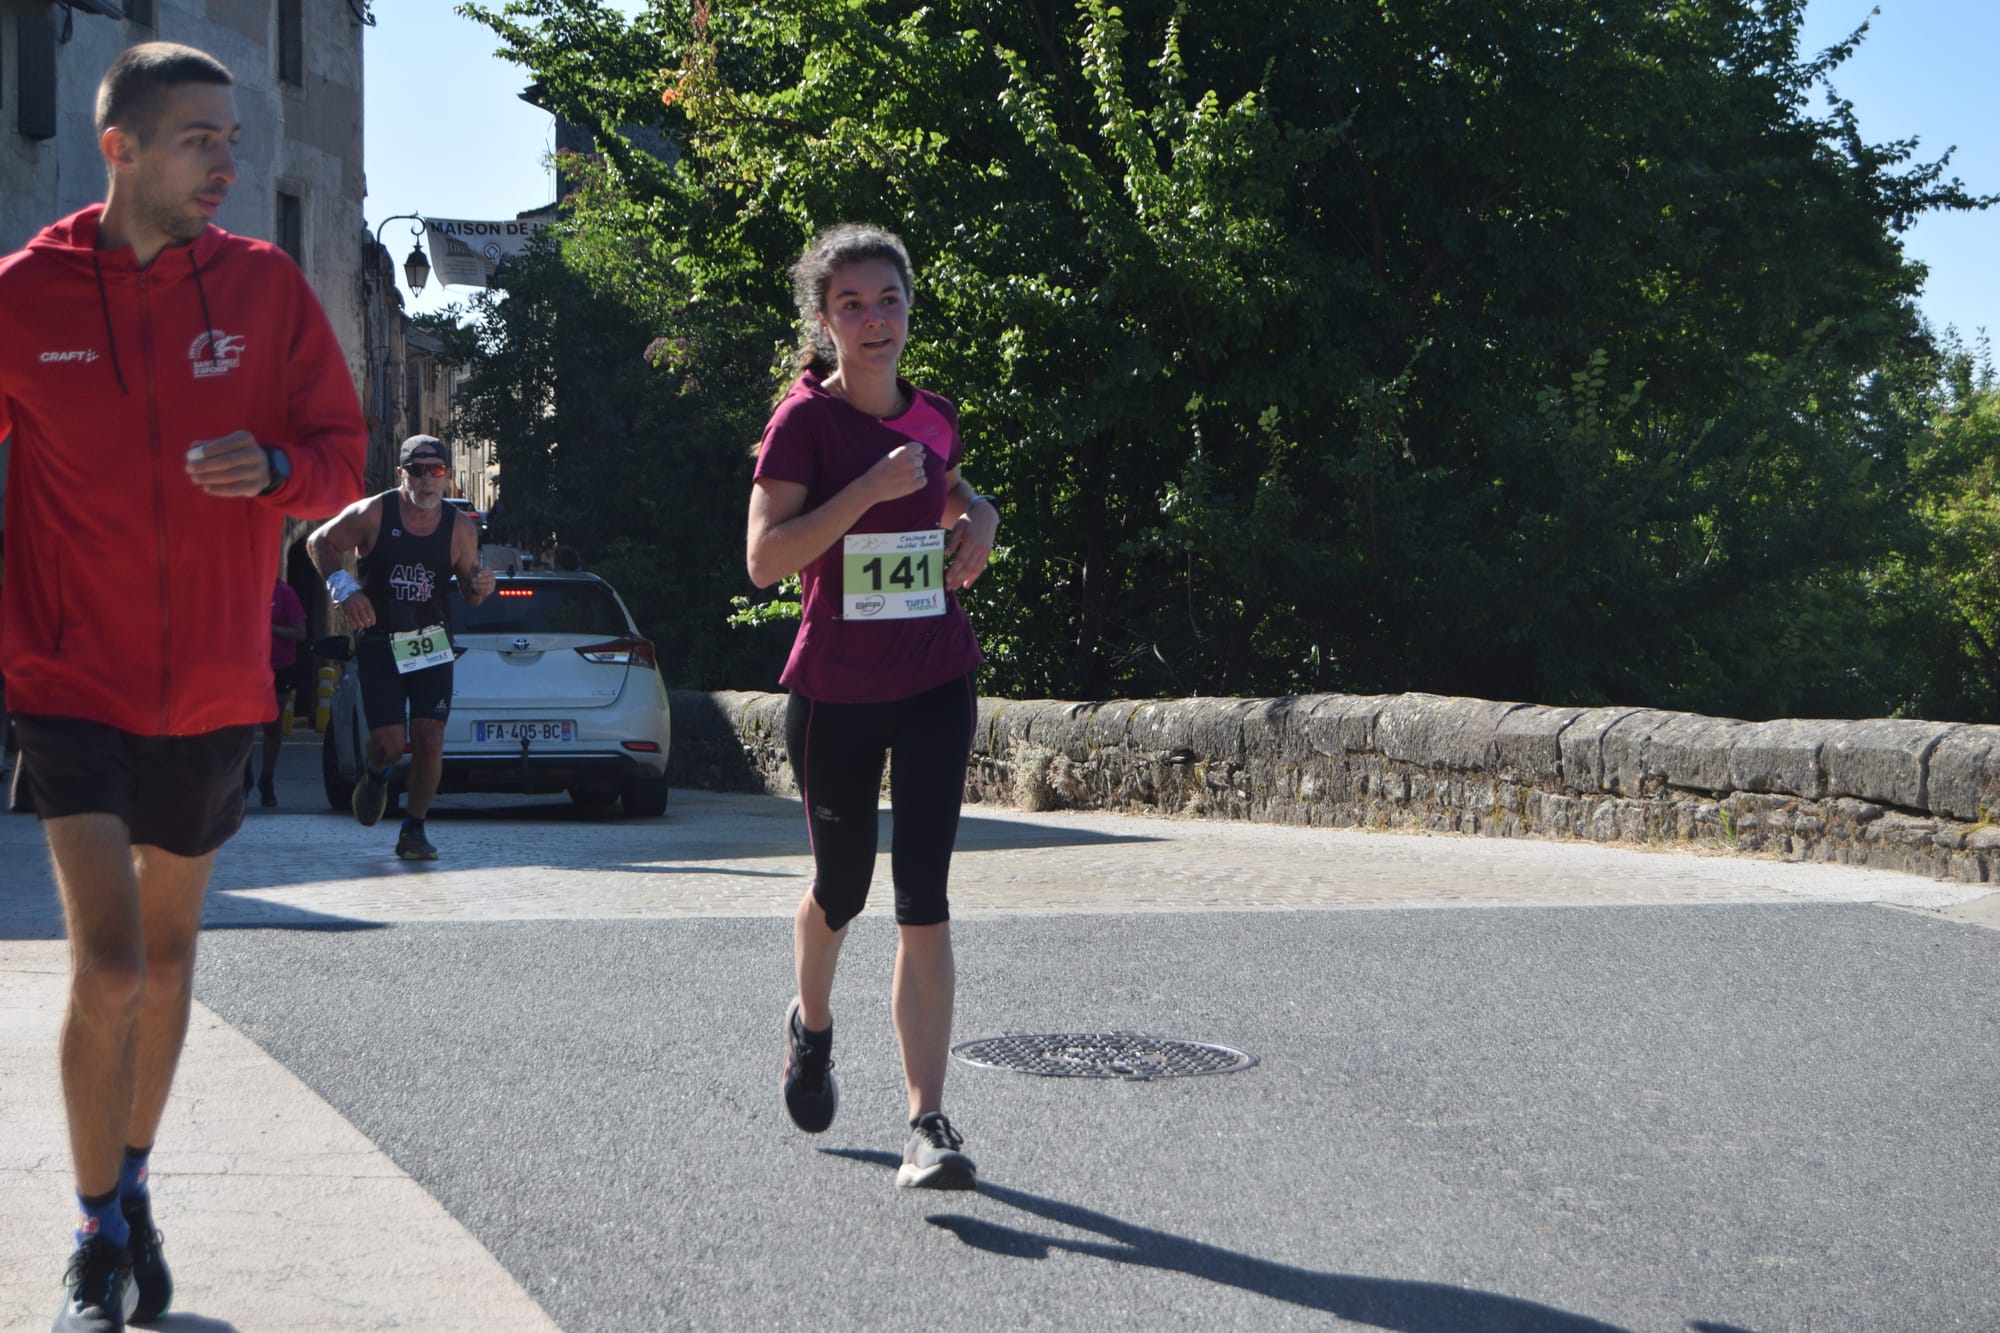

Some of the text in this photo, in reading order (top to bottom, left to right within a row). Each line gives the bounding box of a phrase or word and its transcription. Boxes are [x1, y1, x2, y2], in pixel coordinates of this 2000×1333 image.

[431, 222, 500, 235] MAISON
[507, 222, 528, 235] DE
[40, 351, 86, 363] CRAFT
[863, 554, 929, 590] 141
[407, 637, 434, 657] 39
